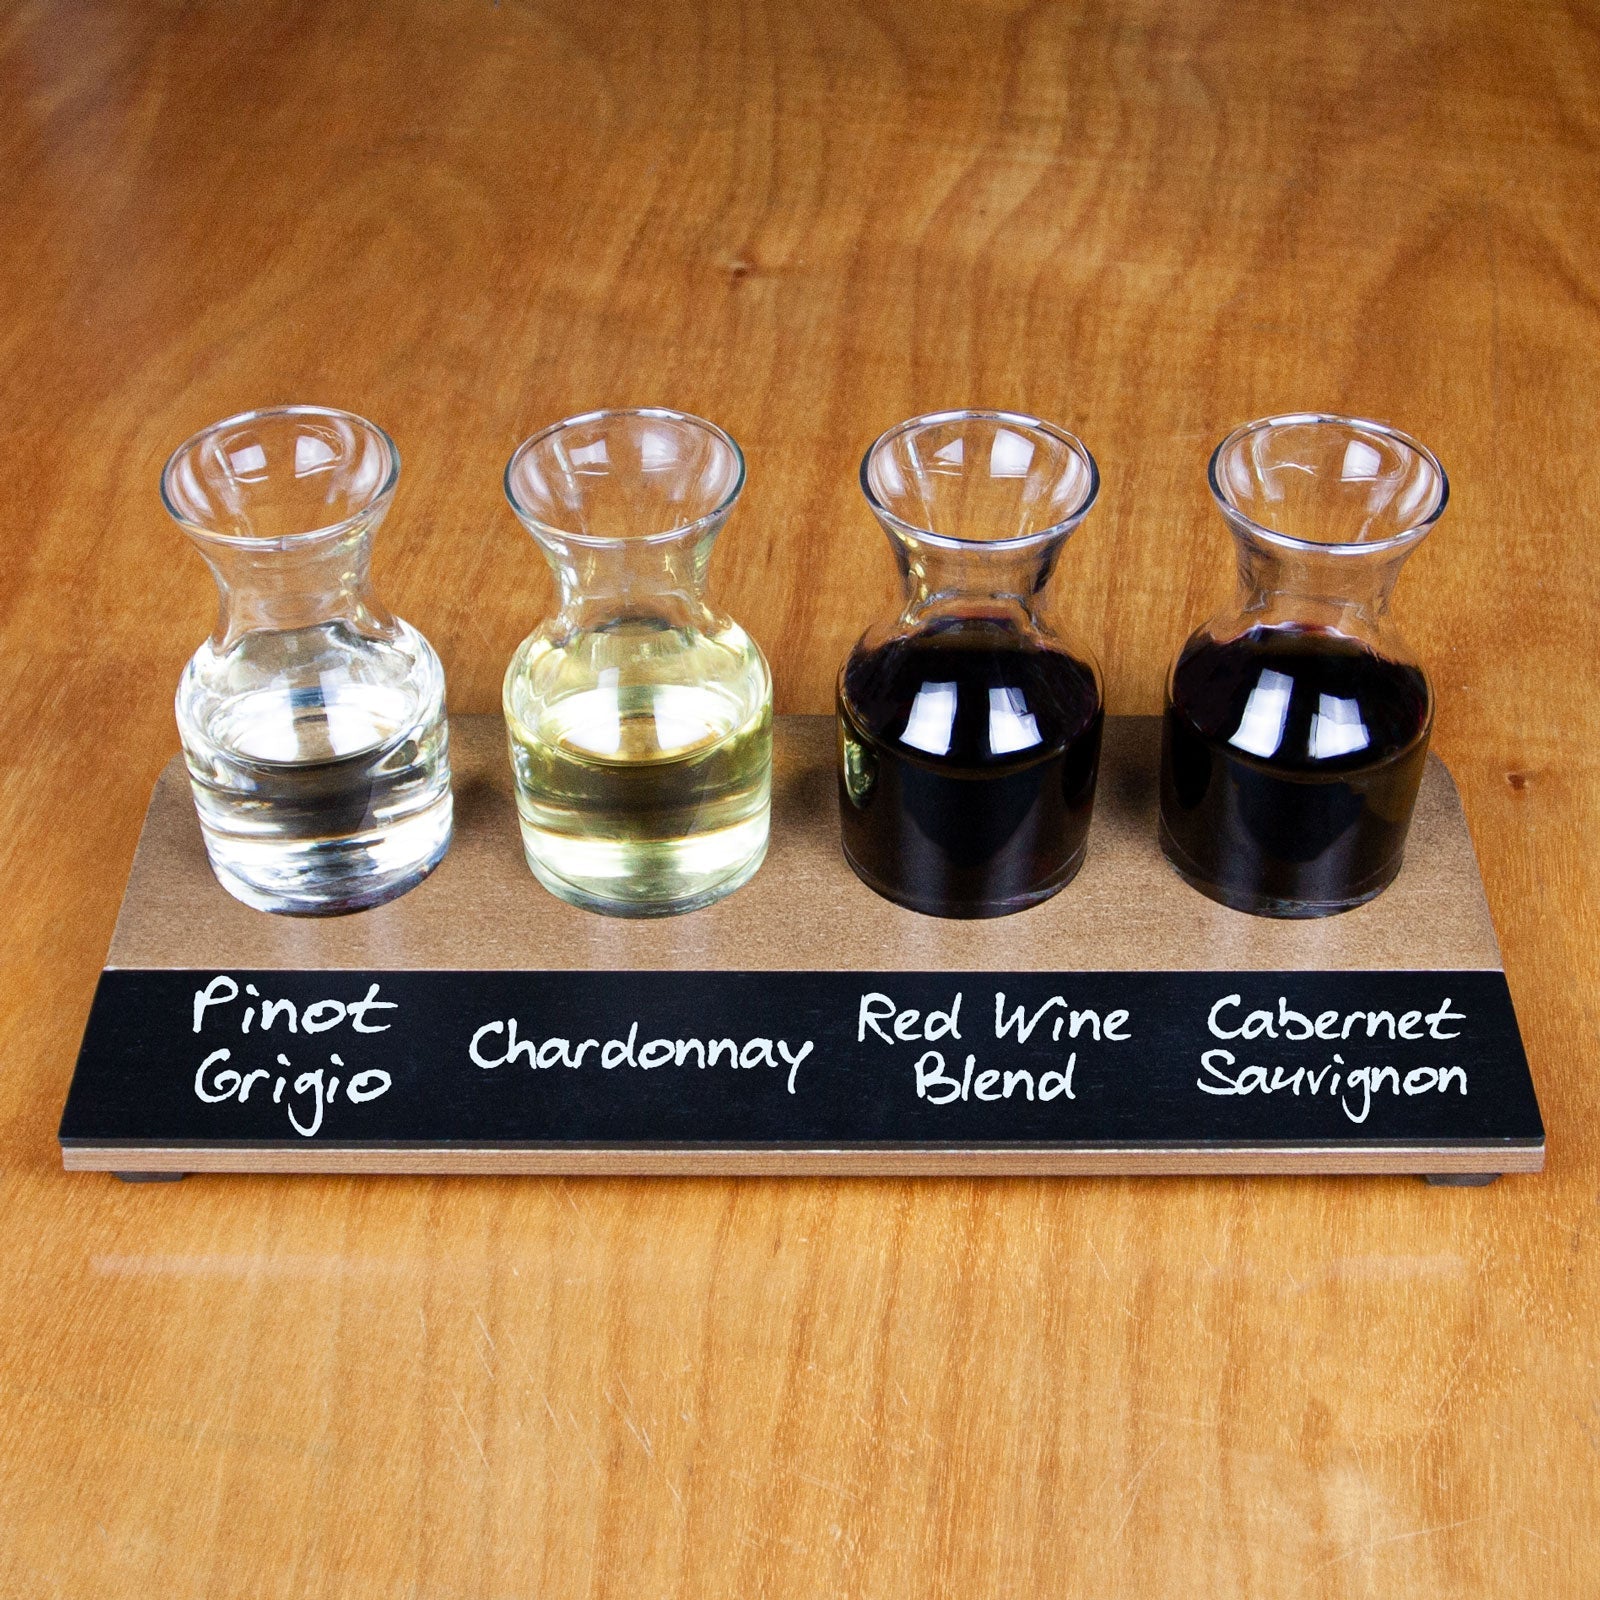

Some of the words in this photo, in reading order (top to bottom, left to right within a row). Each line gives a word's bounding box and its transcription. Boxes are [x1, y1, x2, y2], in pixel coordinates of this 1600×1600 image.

[193, 975, 398, 1035] Pinot
[857, 991, 962, 1045] Red
[994, 992, 1132, 1044] Wine
[1207, 993, 1467, 1041] Cabernet
[469, 1017, 814, 1095] Chardonnay
[914, 1050, 1077, 1105] Blend
[1196, 1048, 1468, 1124] Sauvignon
[194, 1048, 391, 1137] Grigio
